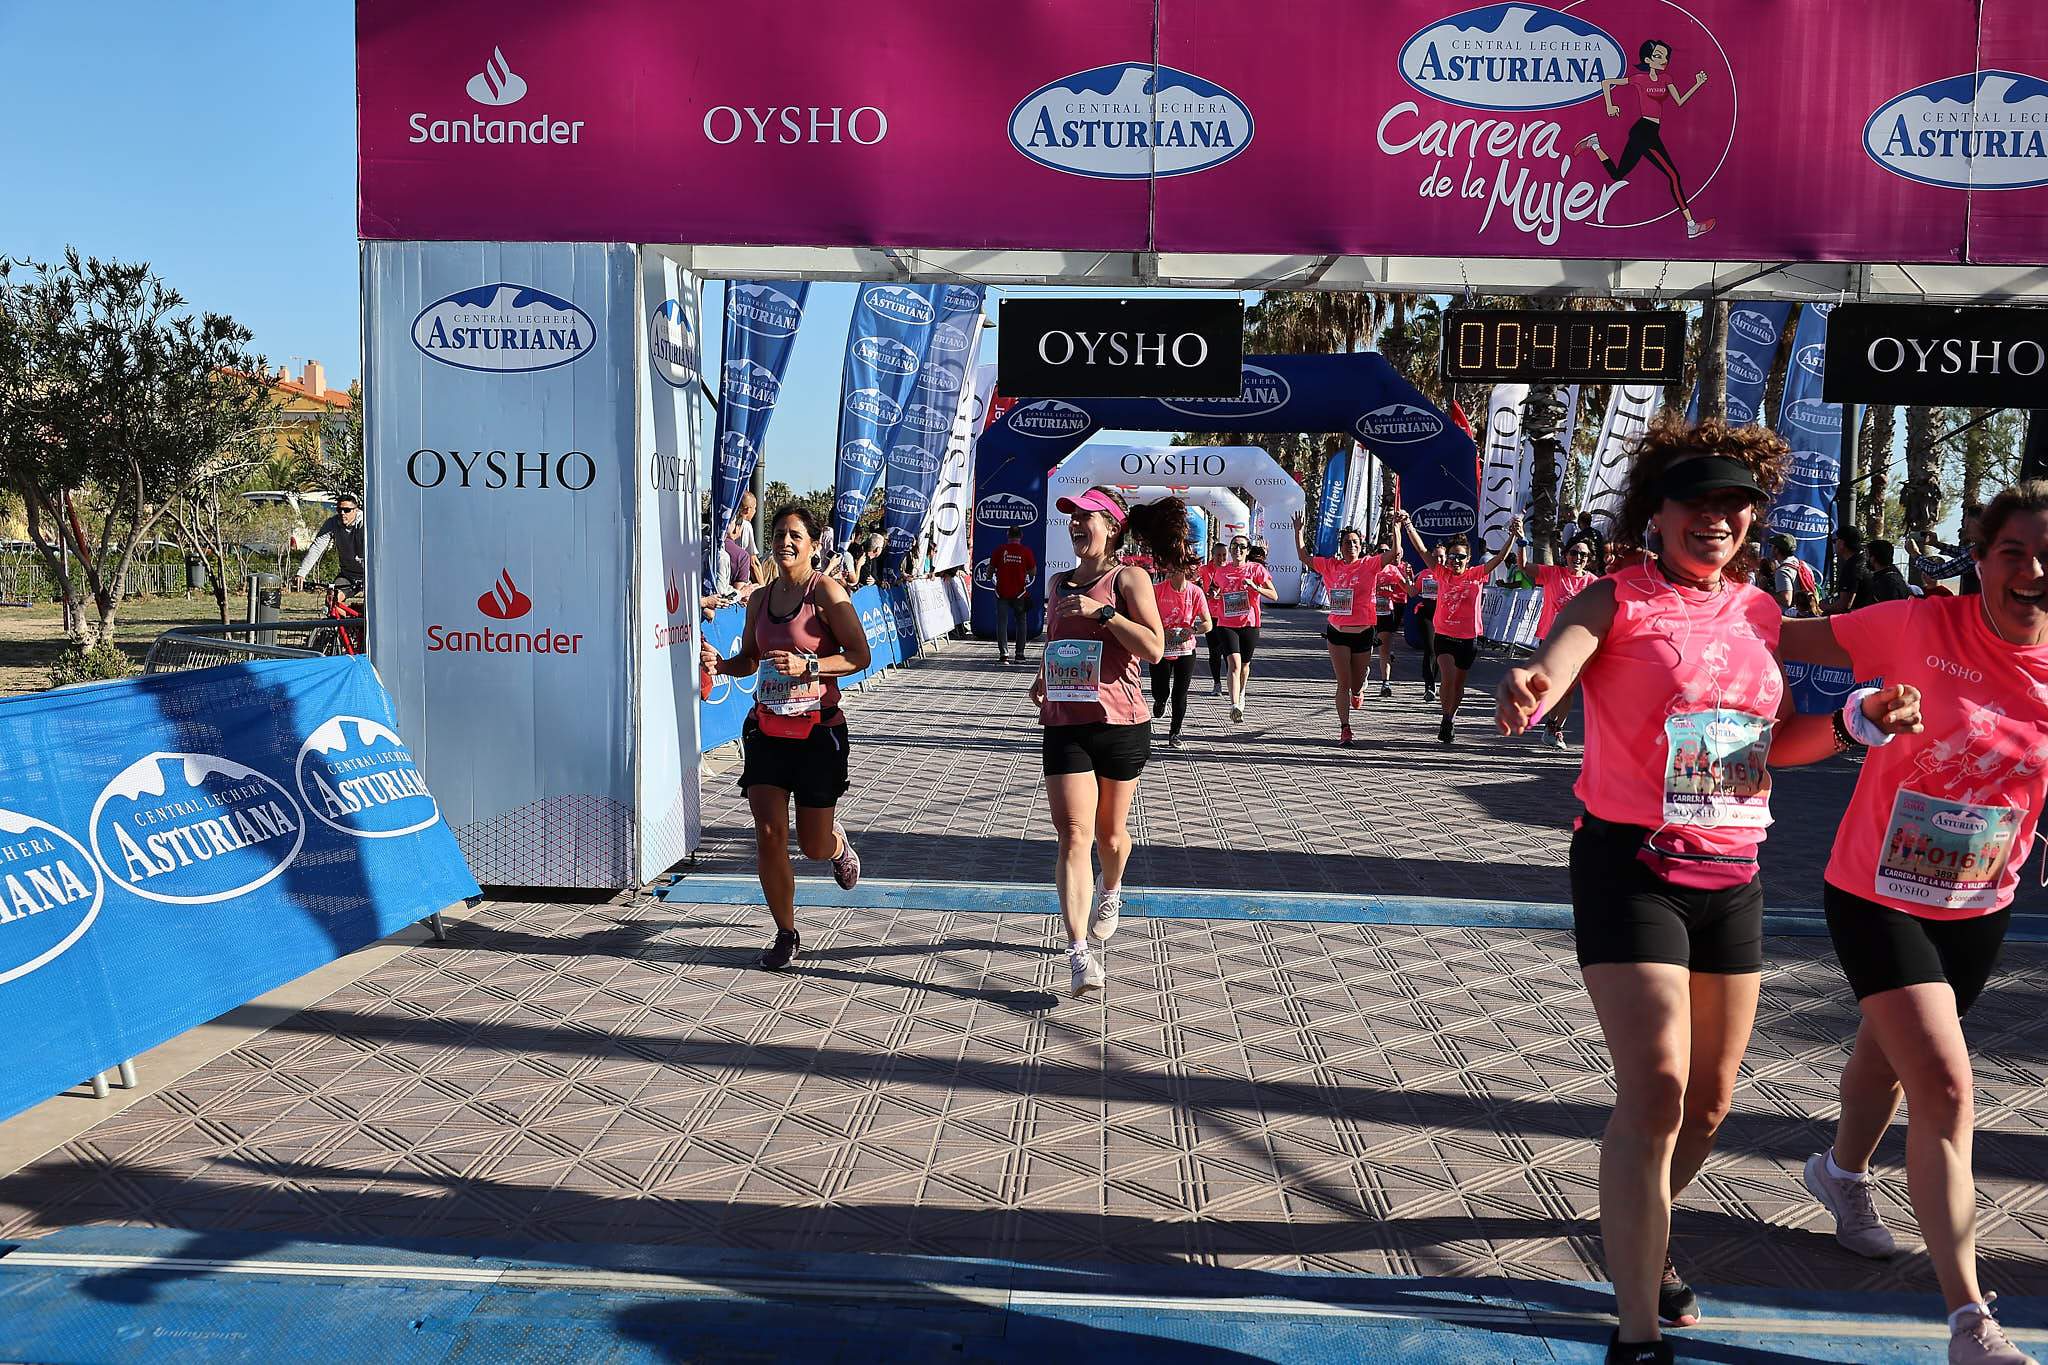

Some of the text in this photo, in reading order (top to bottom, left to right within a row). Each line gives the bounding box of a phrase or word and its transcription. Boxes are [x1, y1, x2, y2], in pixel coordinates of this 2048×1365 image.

[1451, 39, 1602, 52] CENTRAL LECHERA
[1415, 41, 1606, 84] ASTURIANA
[1065, 103, 1141, 114] CENTRAL
[1922, 111, 2001, 123] CENTRAL
[408, 112, 586, 145] Santander
[702, 105, 888, 146] OYSHO
[1027, 105, 1235, 148] ASTURIANA
[1377, 101, 1565, 159] Carrera
[1419, 155, 1630, 246] de la Mujer
[453, 313, 577, 324] CENTRAL LECHERA
[868, 291, 929, 321] ASTURIANA
[425, 315, 583, 351] ASTURIANA
[653, 322, 696, 372] ASTURIANA
[1459, 322, 1667, 371] 00:41:26
[857, 342, 914, 372] ASTURIANA
[1038, 330, 1209, 368] OYSHO
[1867, 337, 2045, 376] OYSHO
[1013, 413, 1084, 429] ASTURIANA
[1363, 419, 1438, 435] ASTURIANA
[406, 450, 597, 491] OYSHO
[650, 452, 696, 494] OYSHO
[1120, 453, 1226, 476] OYSHO
[1057, 476, 1090, 484] OYSHO
[1254, 478, 1287, 486] OYSHO
[979, 506, 1034, 521] ASTURIANA
[1414, 513, 1473, 528] ASTURIANA
[1770, 513, 1829, 534] ASTURIANA
[426, 625, 584, 655] Santander
[655, 623, 692, 651] Santander
[1926, 654, 1983, 683] OYSHO
[326, 756, 376, 776] CENTRAL
[133, 783, 267, 828] CENTRAL LECHERA
[1934, 815, 1985, 832] ASTURIANA
[0, 837, 56, 864] HERA
[112, 800, 298, 883] ASTURIANA
[1927, 847, 1976, 869] 016
[1884, 868, 1917, 881] CARRERA
[1918, 875, 1928, 884] DE
[1929, 878, 1939, 887] LA
[1889, 881, 1930, 898] OYSHO
